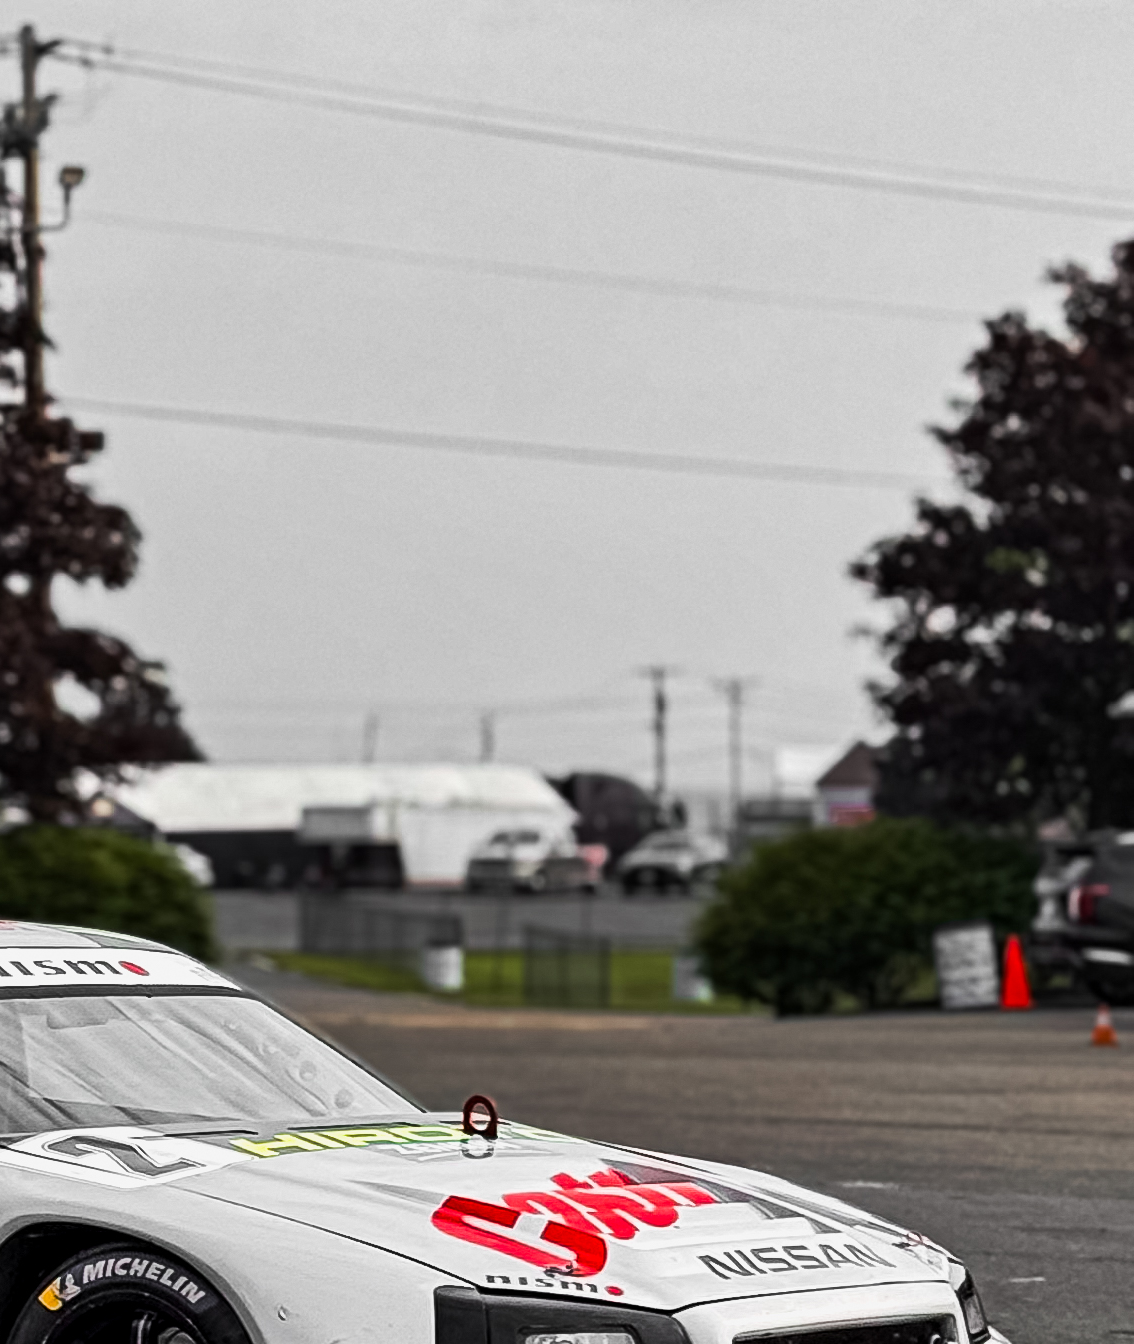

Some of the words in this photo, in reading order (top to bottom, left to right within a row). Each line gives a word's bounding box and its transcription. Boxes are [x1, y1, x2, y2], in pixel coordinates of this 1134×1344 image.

[229, 1122, 586, 1159] HIROO
[82, 1256, 206, 1305] MICHELIN
[697, 1243, 898, 1281] NISSAN
